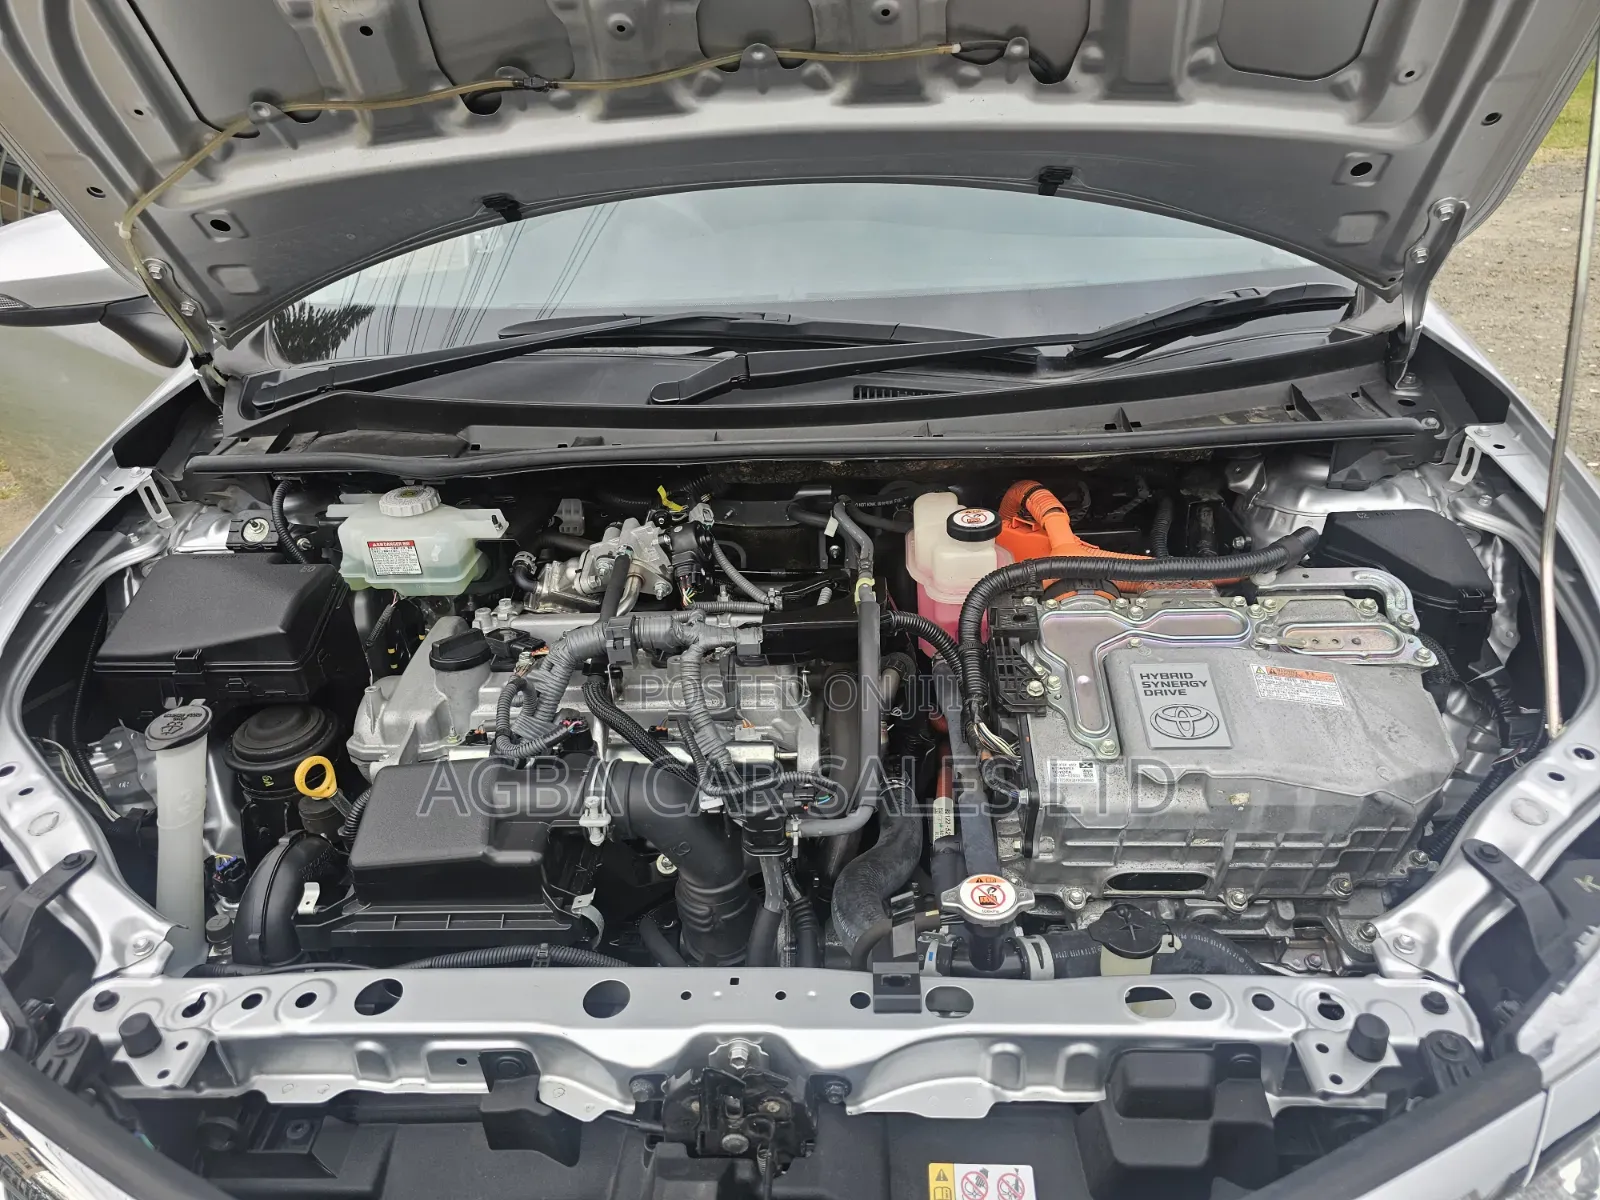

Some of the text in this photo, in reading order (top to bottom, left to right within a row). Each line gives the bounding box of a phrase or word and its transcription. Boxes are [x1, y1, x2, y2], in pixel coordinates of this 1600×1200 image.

[1140, 672, 1193, 680] HYBRID
[1141, 680, 1207, 689] SYNERGY
[1143, 688, 1187, 697] DRIVE
